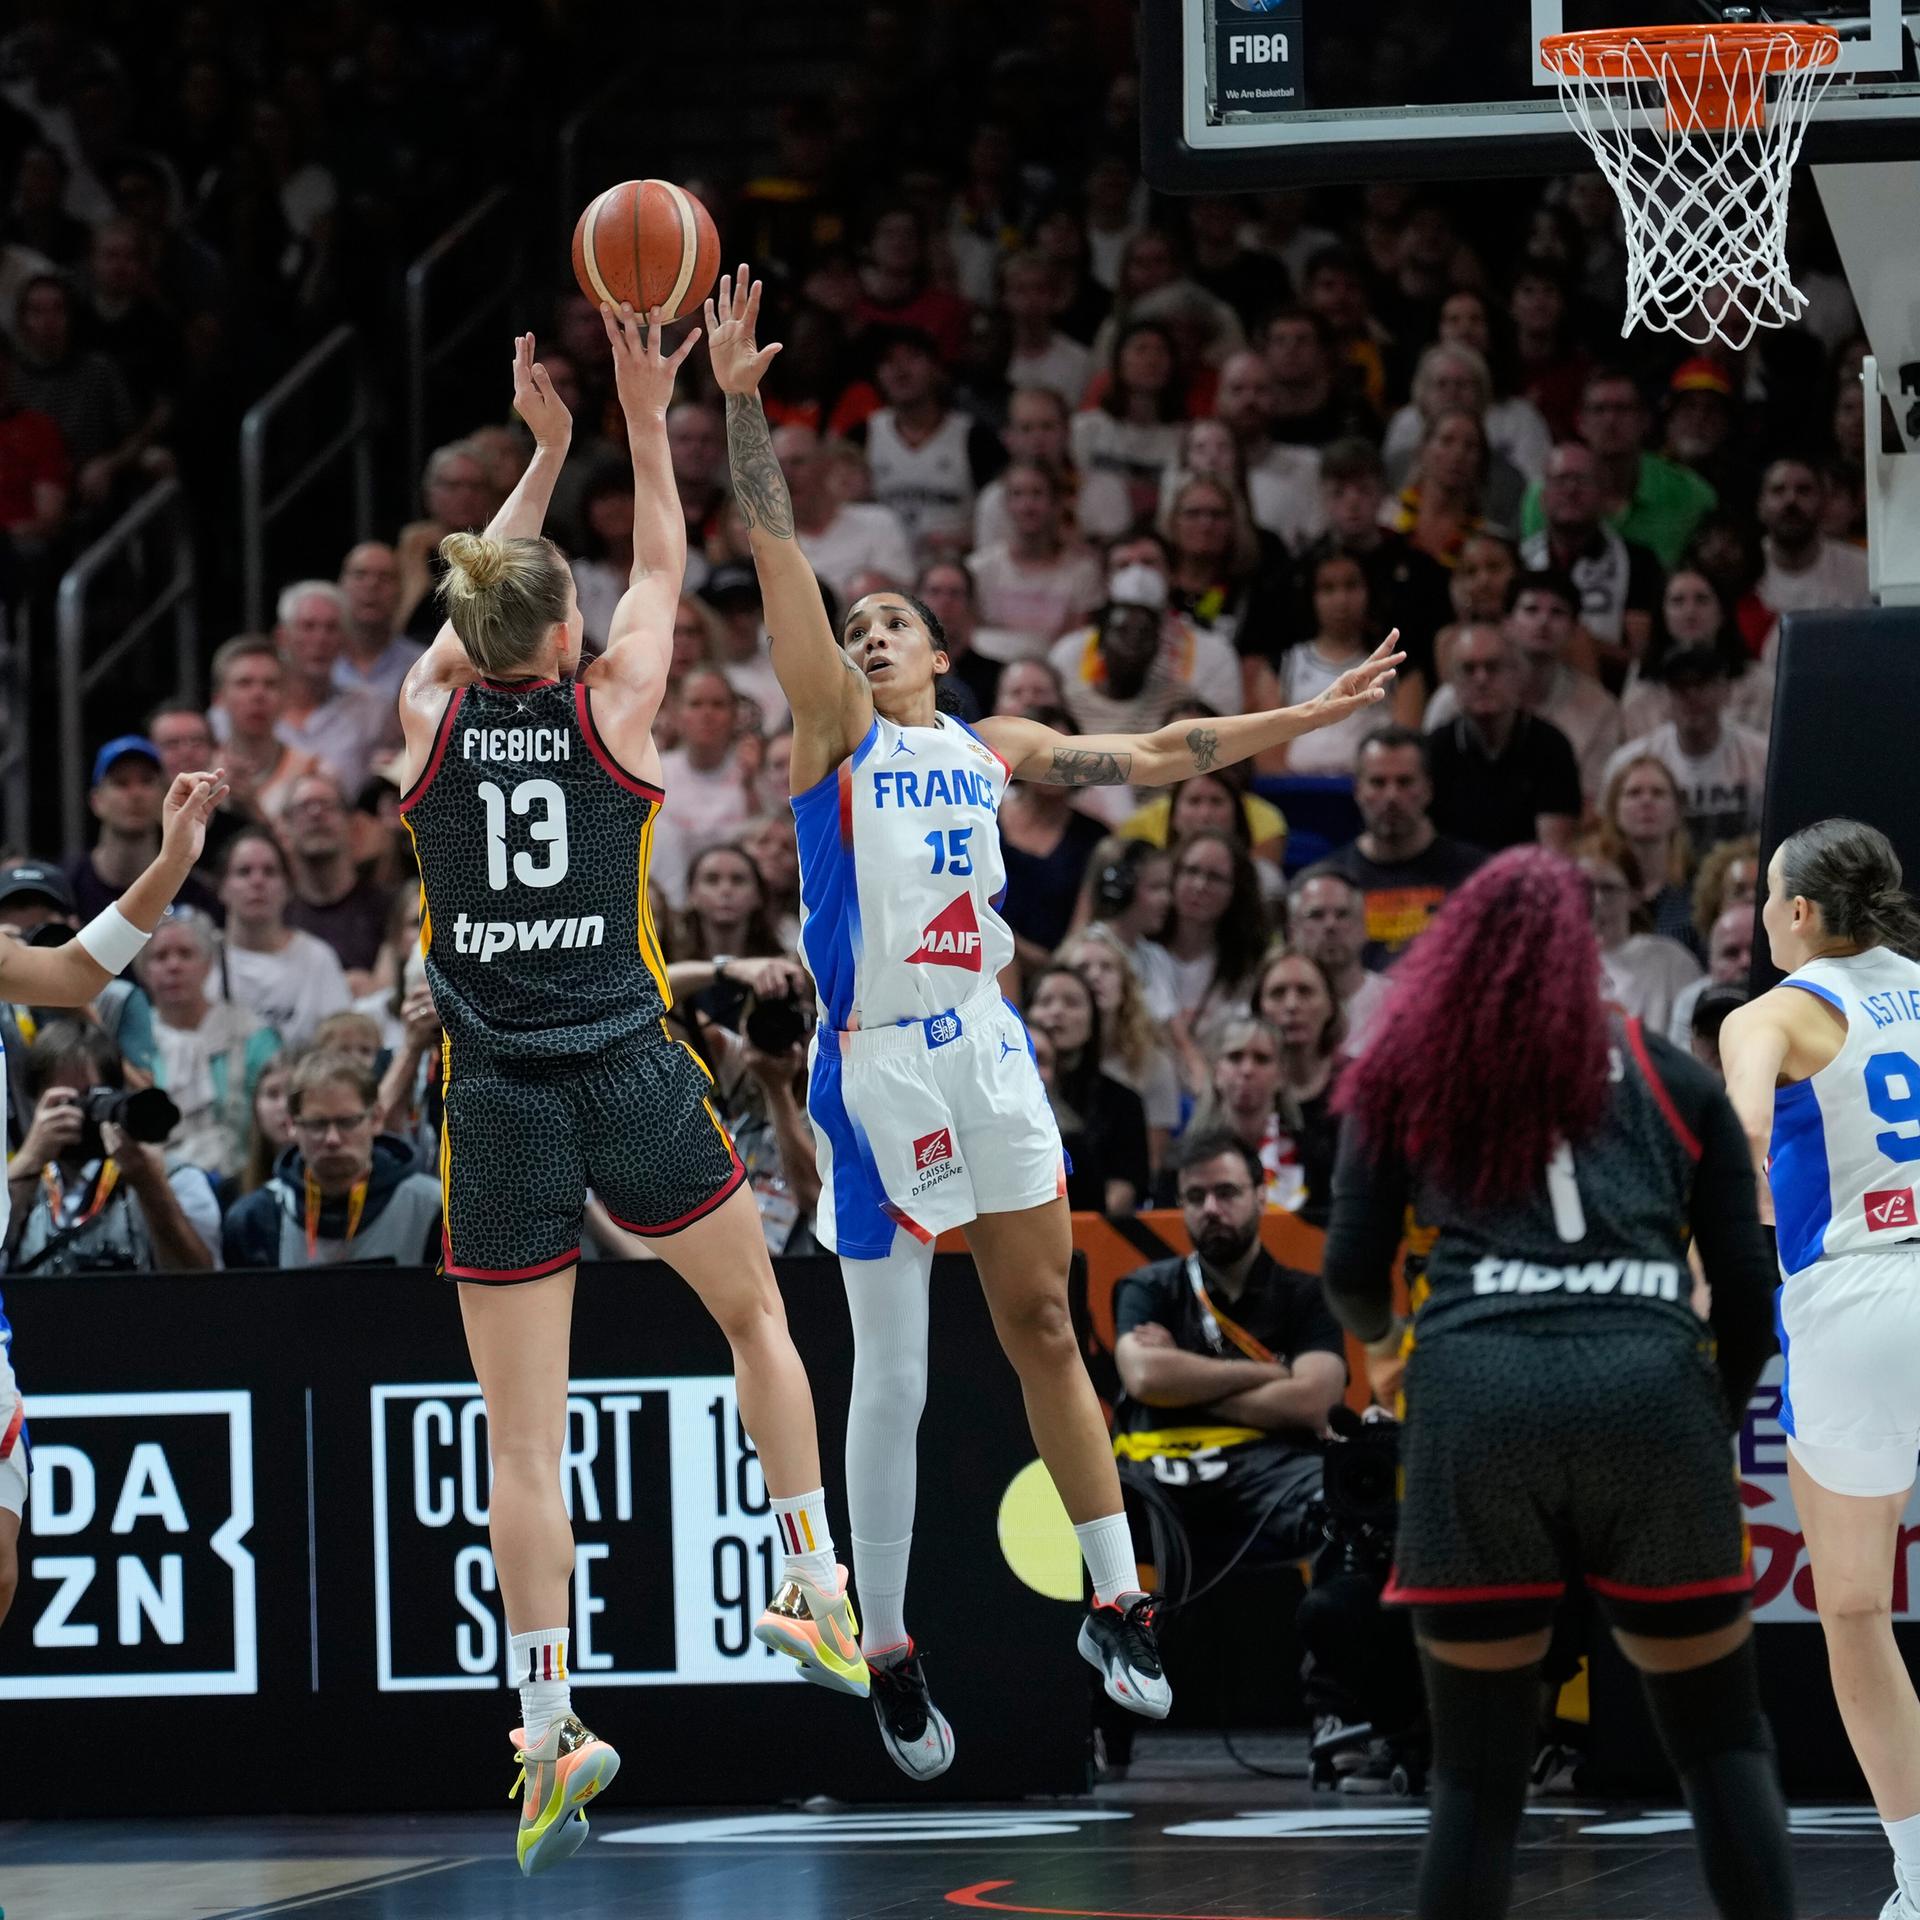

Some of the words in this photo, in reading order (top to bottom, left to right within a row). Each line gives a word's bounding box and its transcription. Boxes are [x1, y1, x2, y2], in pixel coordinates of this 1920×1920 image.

[1229, 33, 1289, 65] FIBA
[1225, 89, 1240, 99] We
[1240, 89, 1255, 99] Are
[1255, 87, 1295, 98] Basketball
[463, 728, 570, 762] FIEBICH
[478, 779, 569, 891] 13
[924, 827, 973, 876] 15
[453, 913, 605, 963] tipwin
[921, 930, 981, 954] MAIF
[1864, 1052, 1920, 1164] 9
[911, 1166, 963, 1196] D'EPARGNE
[919, 1161, 951, 1182] CAISSE
[412, 1396, 642, 1528] CORT
[30, 1443, 190, 1536] DA
[32, 1554, 184, 1648] ZN
[454, 1543, 614, 1674] SE
[712, 1534, 776, 1657] 91
